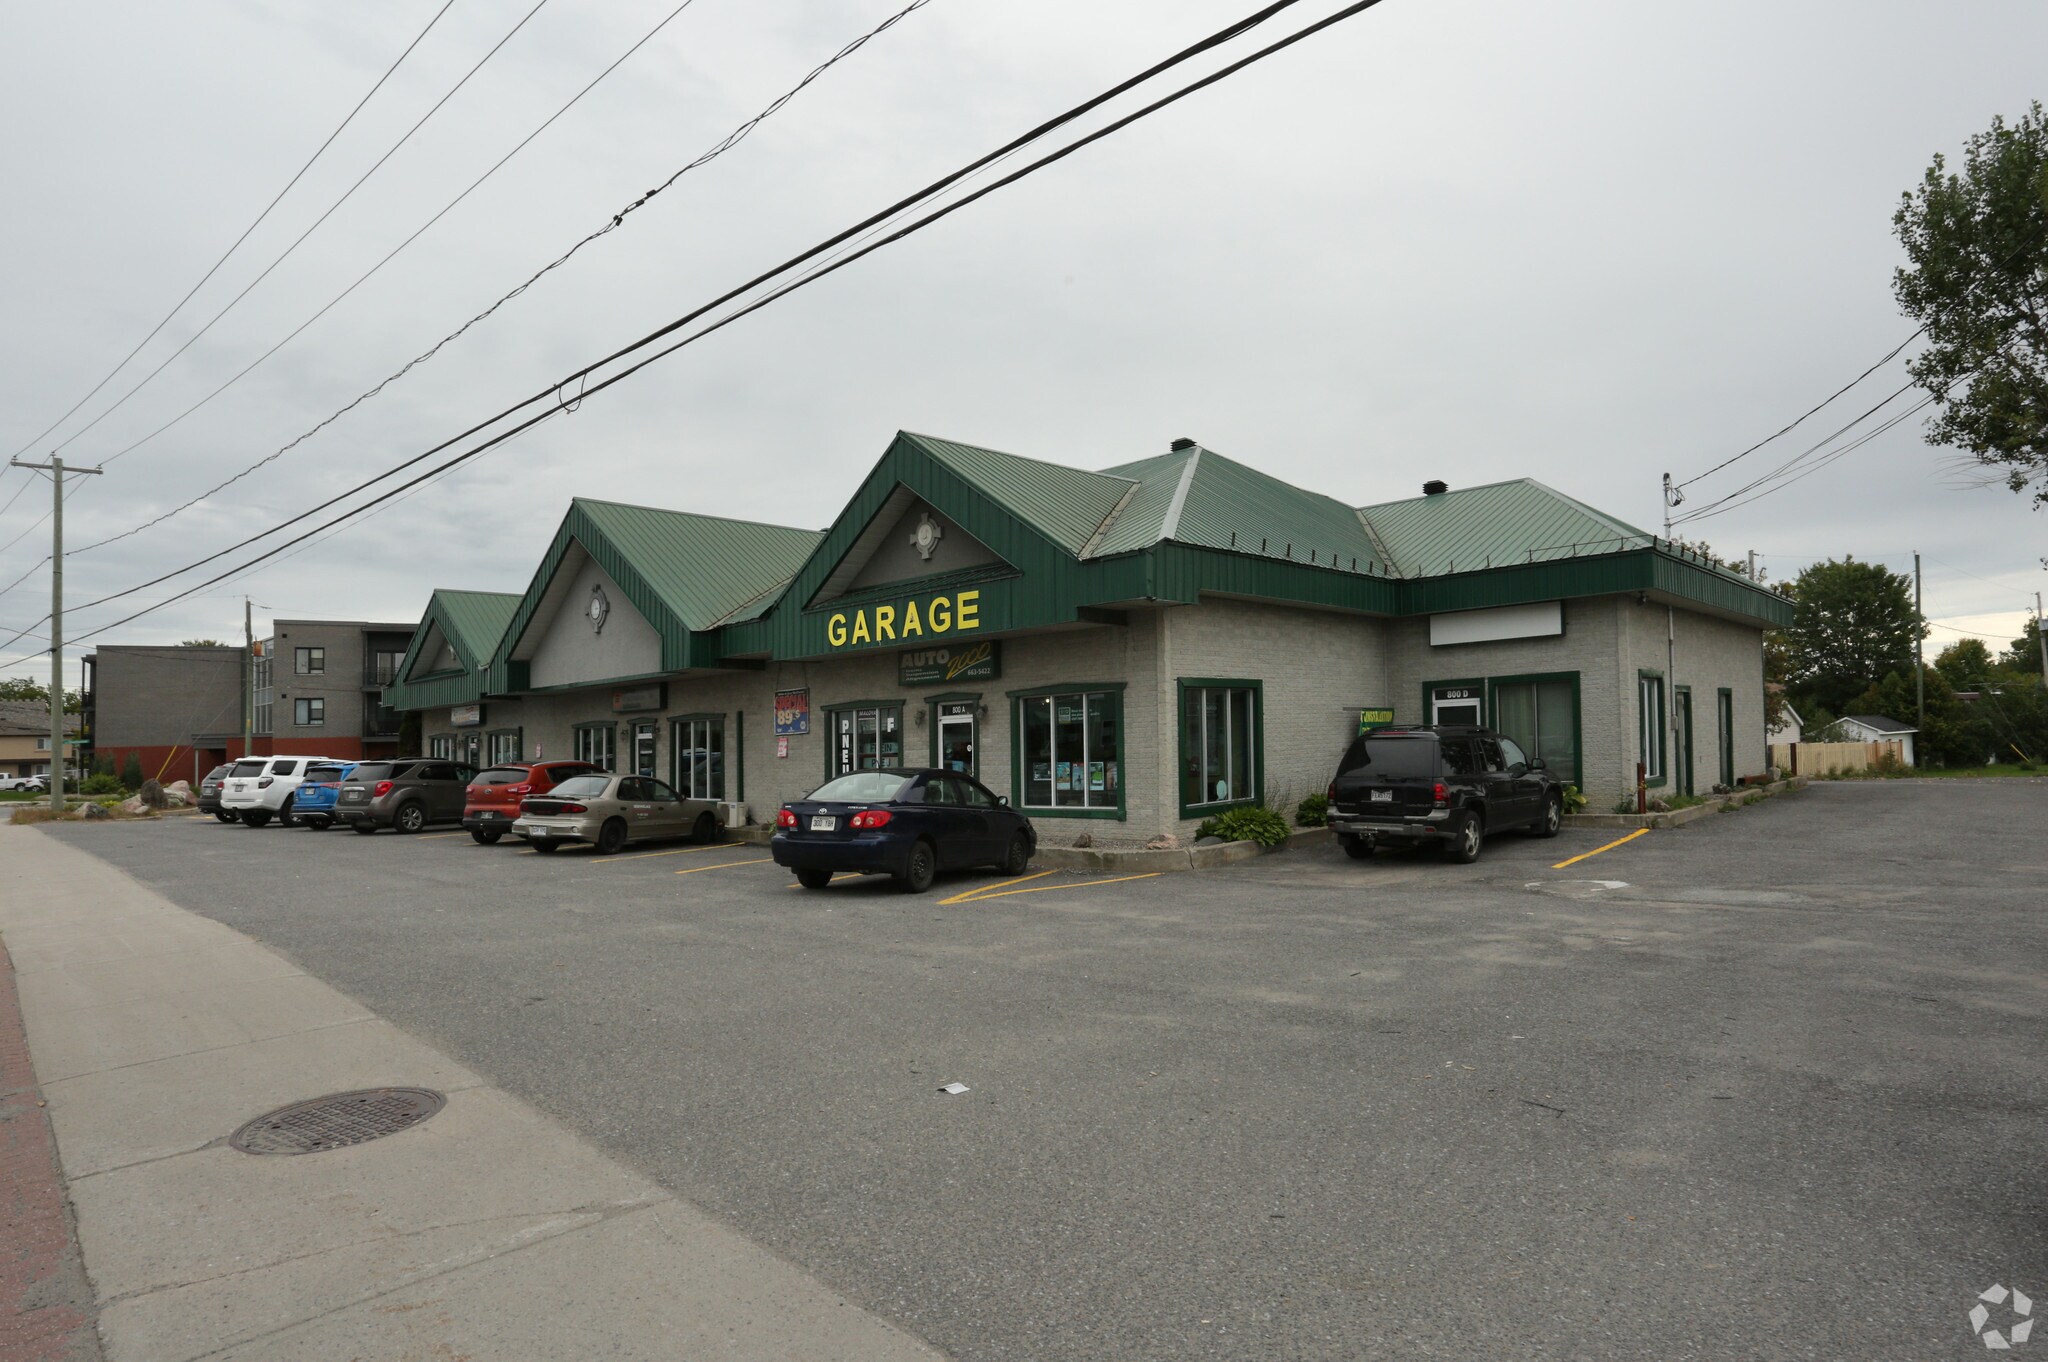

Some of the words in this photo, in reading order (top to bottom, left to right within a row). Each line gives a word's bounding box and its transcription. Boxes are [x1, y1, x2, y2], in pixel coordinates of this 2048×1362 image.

[828, 590, 980, 647] GARAGE
[902, 649, 950, 668] AUTO
[946, 642, 991, 680] 2000
[967, 668, 991, 676] 663-5422
[1447, 690, 1461, 698] 800
[1463, 690, 1468, 698] D
[952, 706, 961, 714] 800
[962, 705, 966, 713] A
[872, 760, 890, 768] PEU
